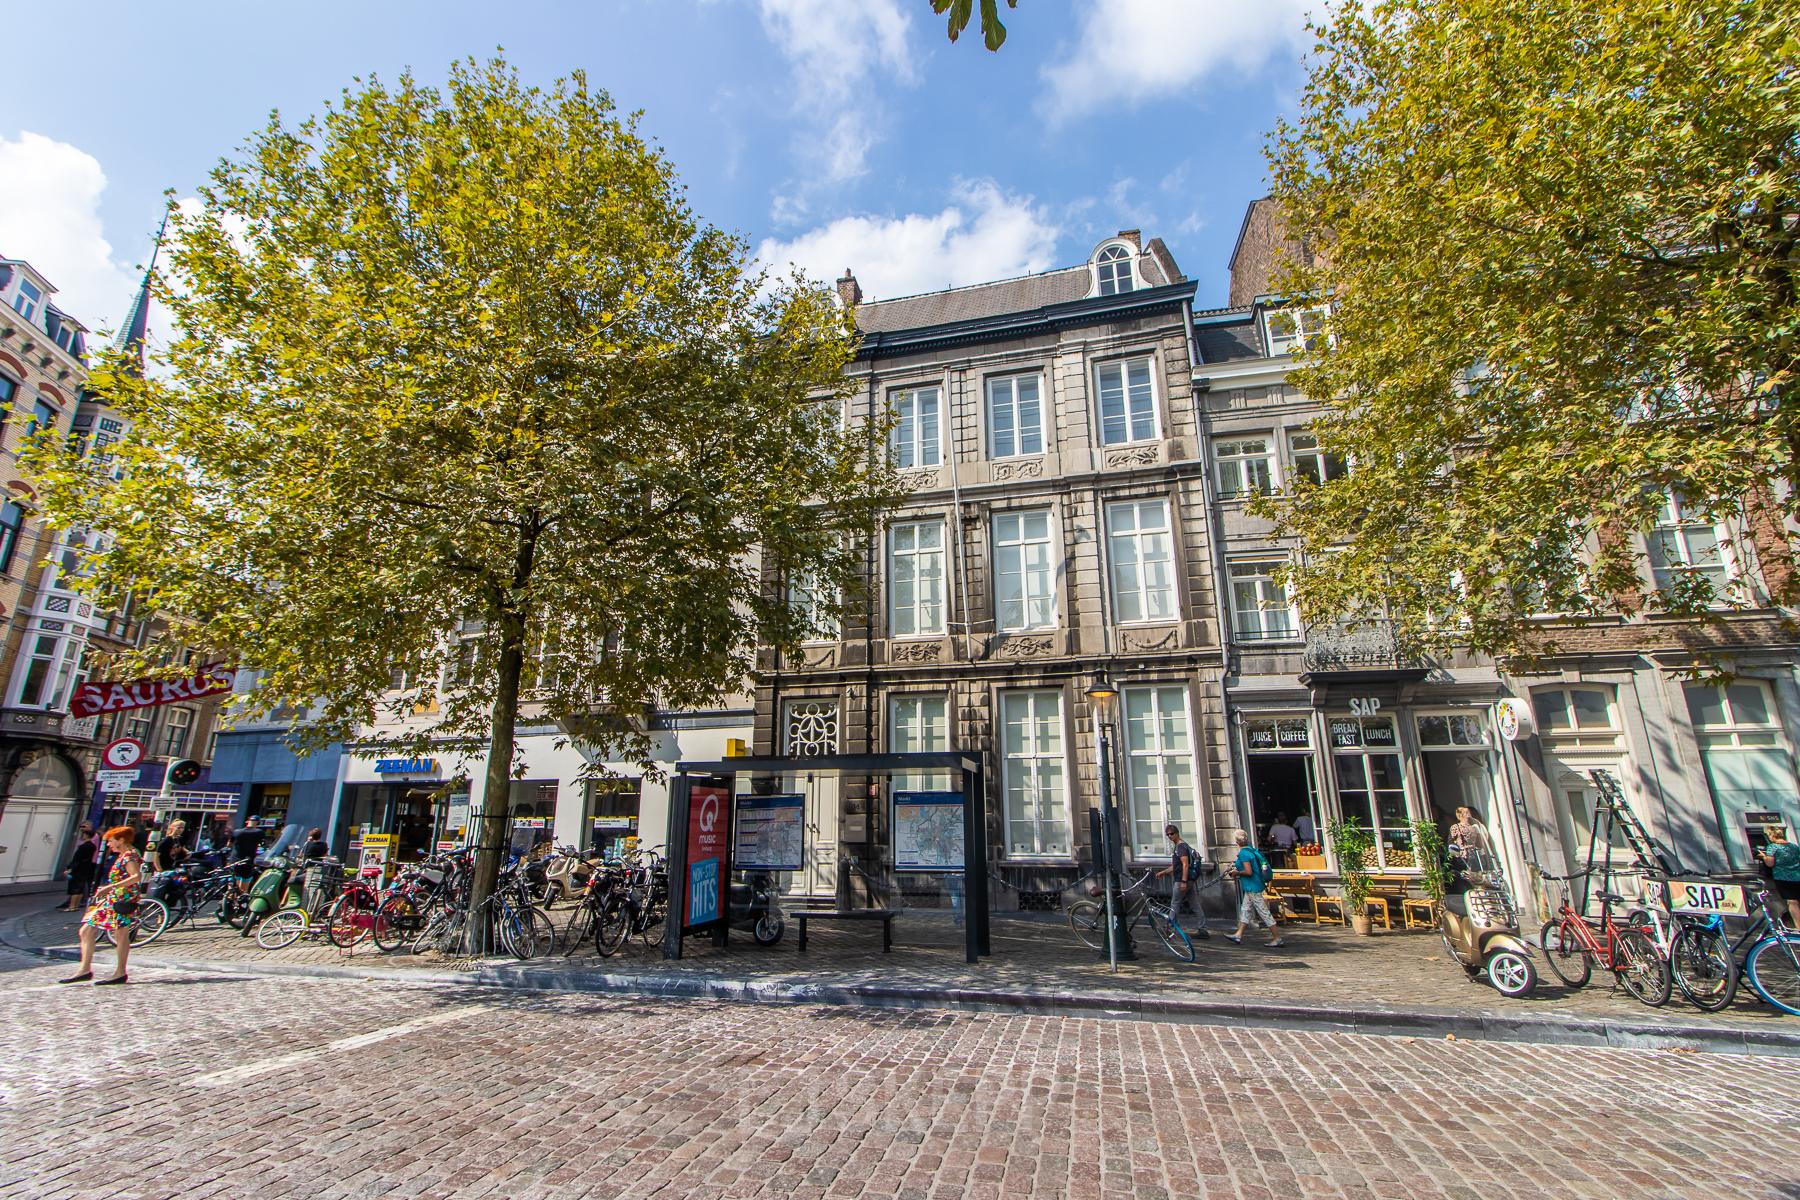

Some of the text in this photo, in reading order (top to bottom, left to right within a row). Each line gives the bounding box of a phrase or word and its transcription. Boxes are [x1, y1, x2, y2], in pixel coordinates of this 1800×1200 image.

[1349, 697, 1381, 716] SAP
[1332, 723, 1357, 734] BREAK
[1366, 728, 1392, 740] LUNCH
[1251, 731, 1272, 742] JUICE
[1280, 730, 1307, 742] COFFEE
[1338, 734, 1356, 745] FAST
[374, 758, 436, 774] ZEEMAN
[699, 794, 719, 832] Q
[698, 834, 716, 844] music
[691, 878, 717, 920] HITS
[1685, 885, 1726, 910] SAP
